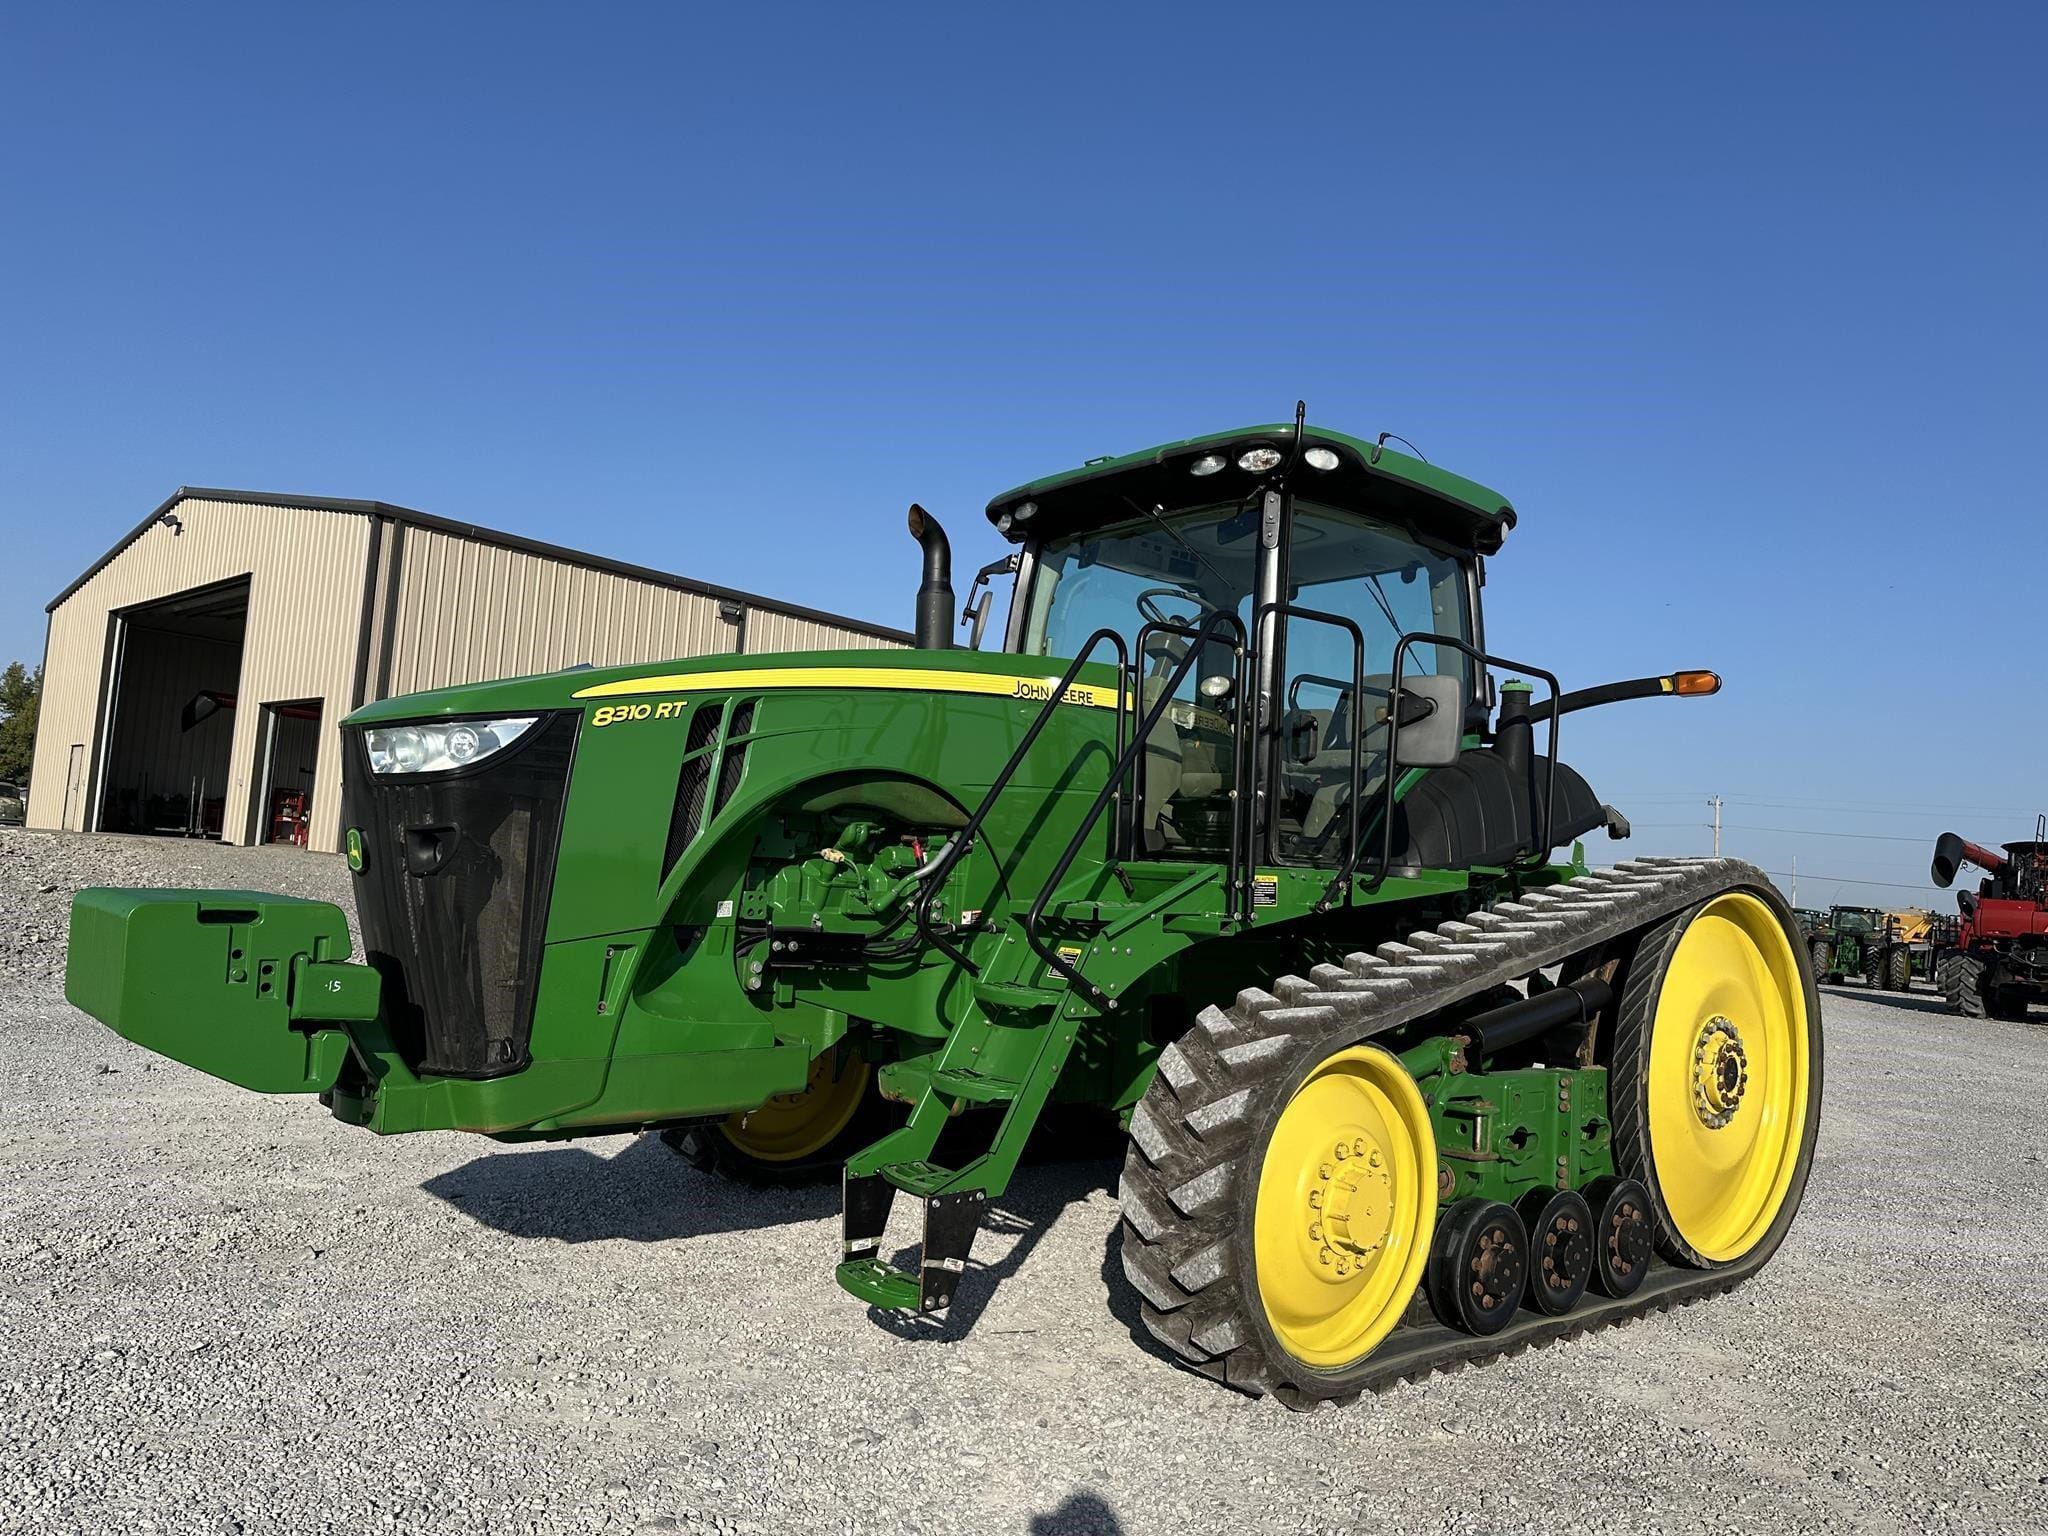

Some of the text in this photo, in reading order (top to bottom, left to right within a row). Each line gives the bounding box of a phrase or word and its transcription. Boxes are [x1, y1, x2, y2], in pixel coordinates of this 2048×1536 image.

[1013, 680, 1094, 705] JOHN EERE
[592, 701, 688, 727] 8310 RT
